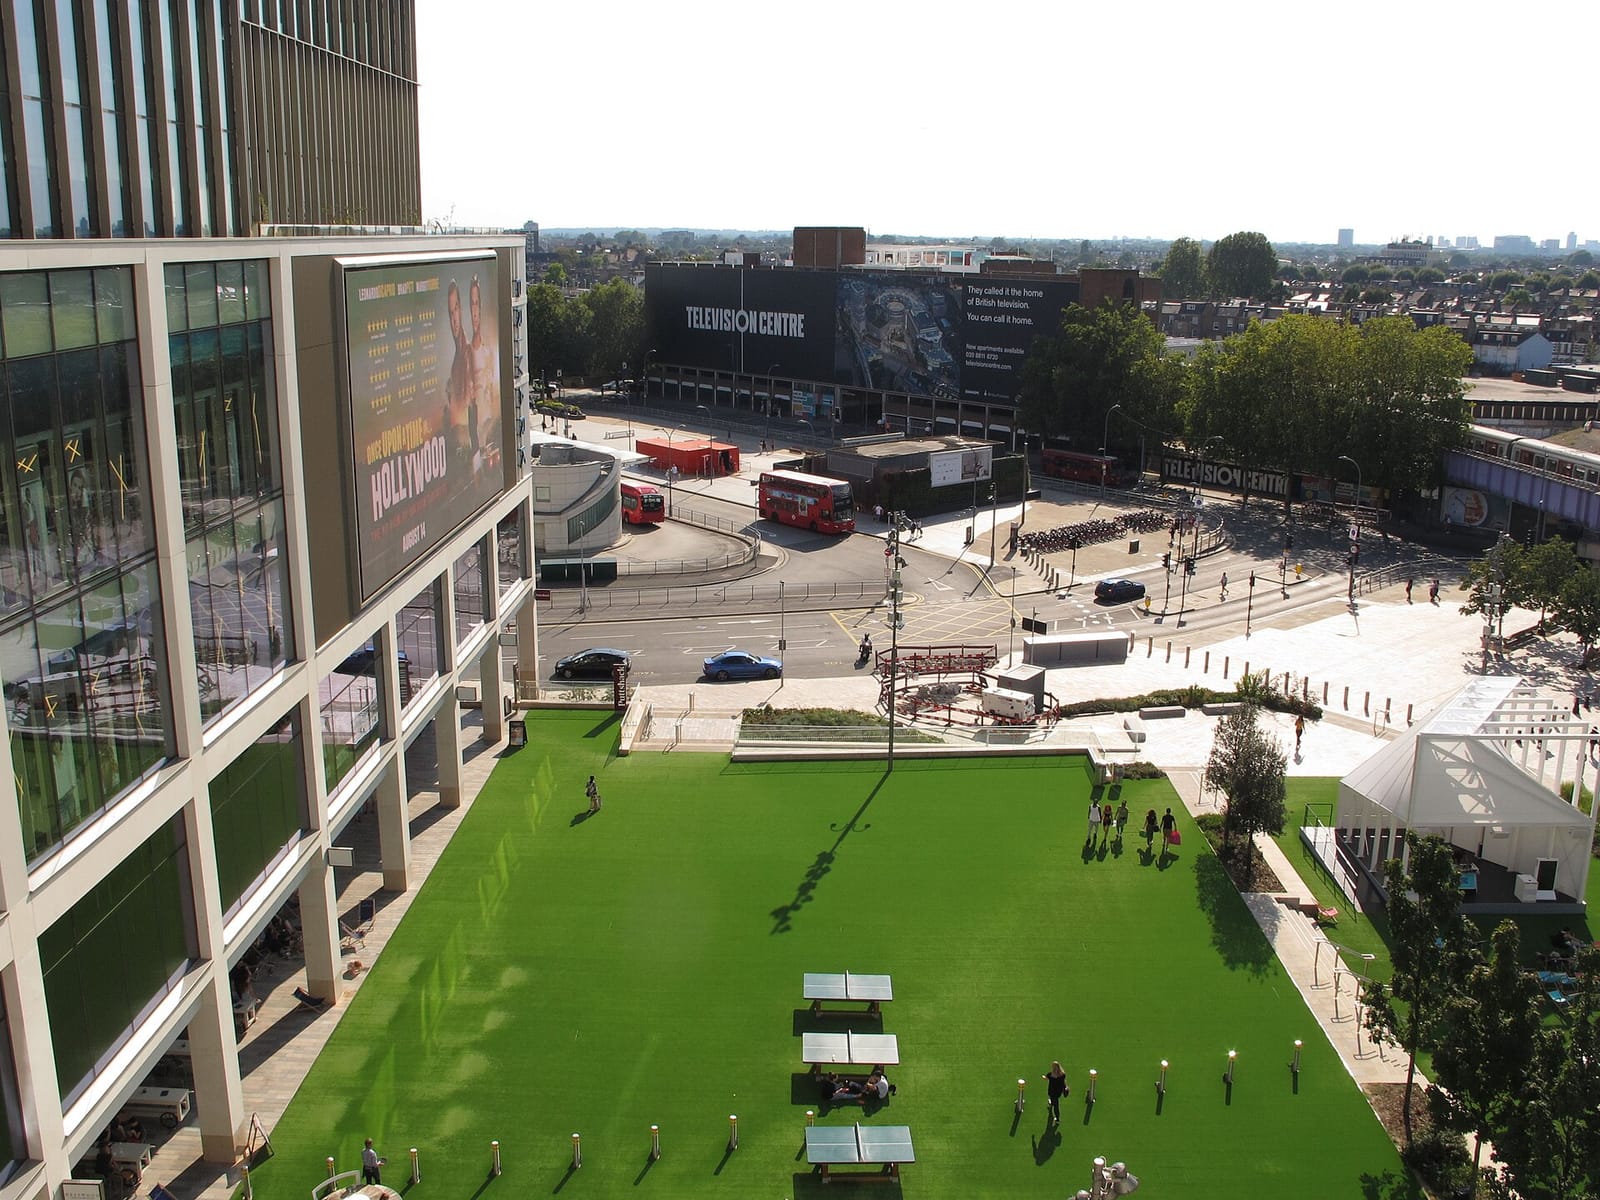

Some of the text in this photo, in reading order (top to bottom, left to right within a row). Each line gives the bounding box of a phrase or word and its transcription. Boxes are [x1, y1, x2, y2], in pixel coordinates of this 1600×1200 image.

[967, 298, 1030, 309] of British television.
[968, 286, 1044, 298] They called it the home
[686, 306, 805, 338] TELEVISION CENTRE
[967, 312, 1034, 325] You can call it home.
[381, 424, 403, 458] UPON
[405, 417, 424, 451] TIME
[371, 435, 447, 522] HOLLYWOOD
[402, 529, 420, 553] AUGUST
[617, 666, 626, 706] Puttshack
